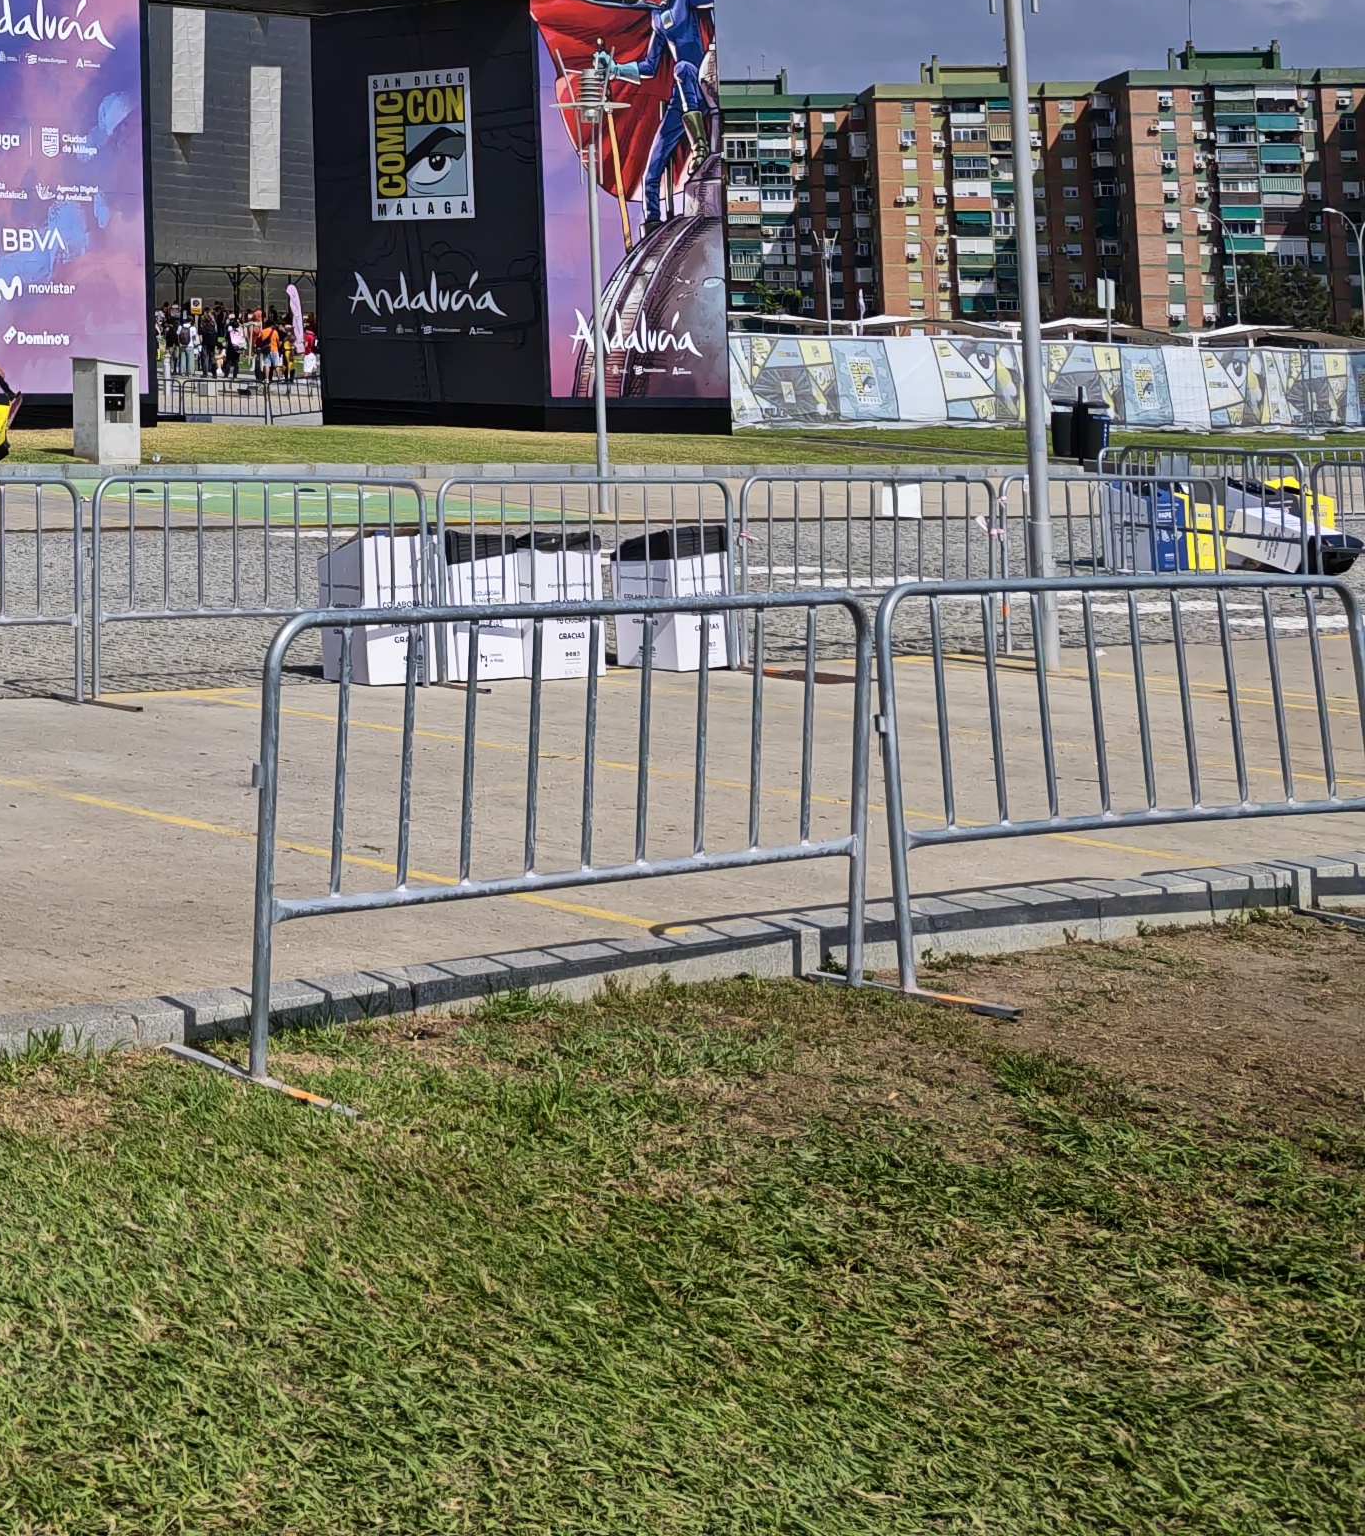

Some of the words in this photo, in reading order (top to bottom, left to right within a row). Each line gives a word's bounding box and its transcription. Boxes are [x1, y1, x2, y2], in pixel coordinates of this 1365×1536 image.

[372, 77, 401, 90] SAN
[414, 72, 465, 86] DIEGO
[406, 86, 465, 124] CON
[375, 91, 407, 197] COMIC
[377, 199, 469, 217] MÁLAGA
[2, 226, 66, 253] BBVA
[28, 281, 76, 295] movistar
[348, 270, 509, 317] Andalucía
[17, 330, 71, 346] Domino's
[558, 632, 585, 640] GRACIAS
